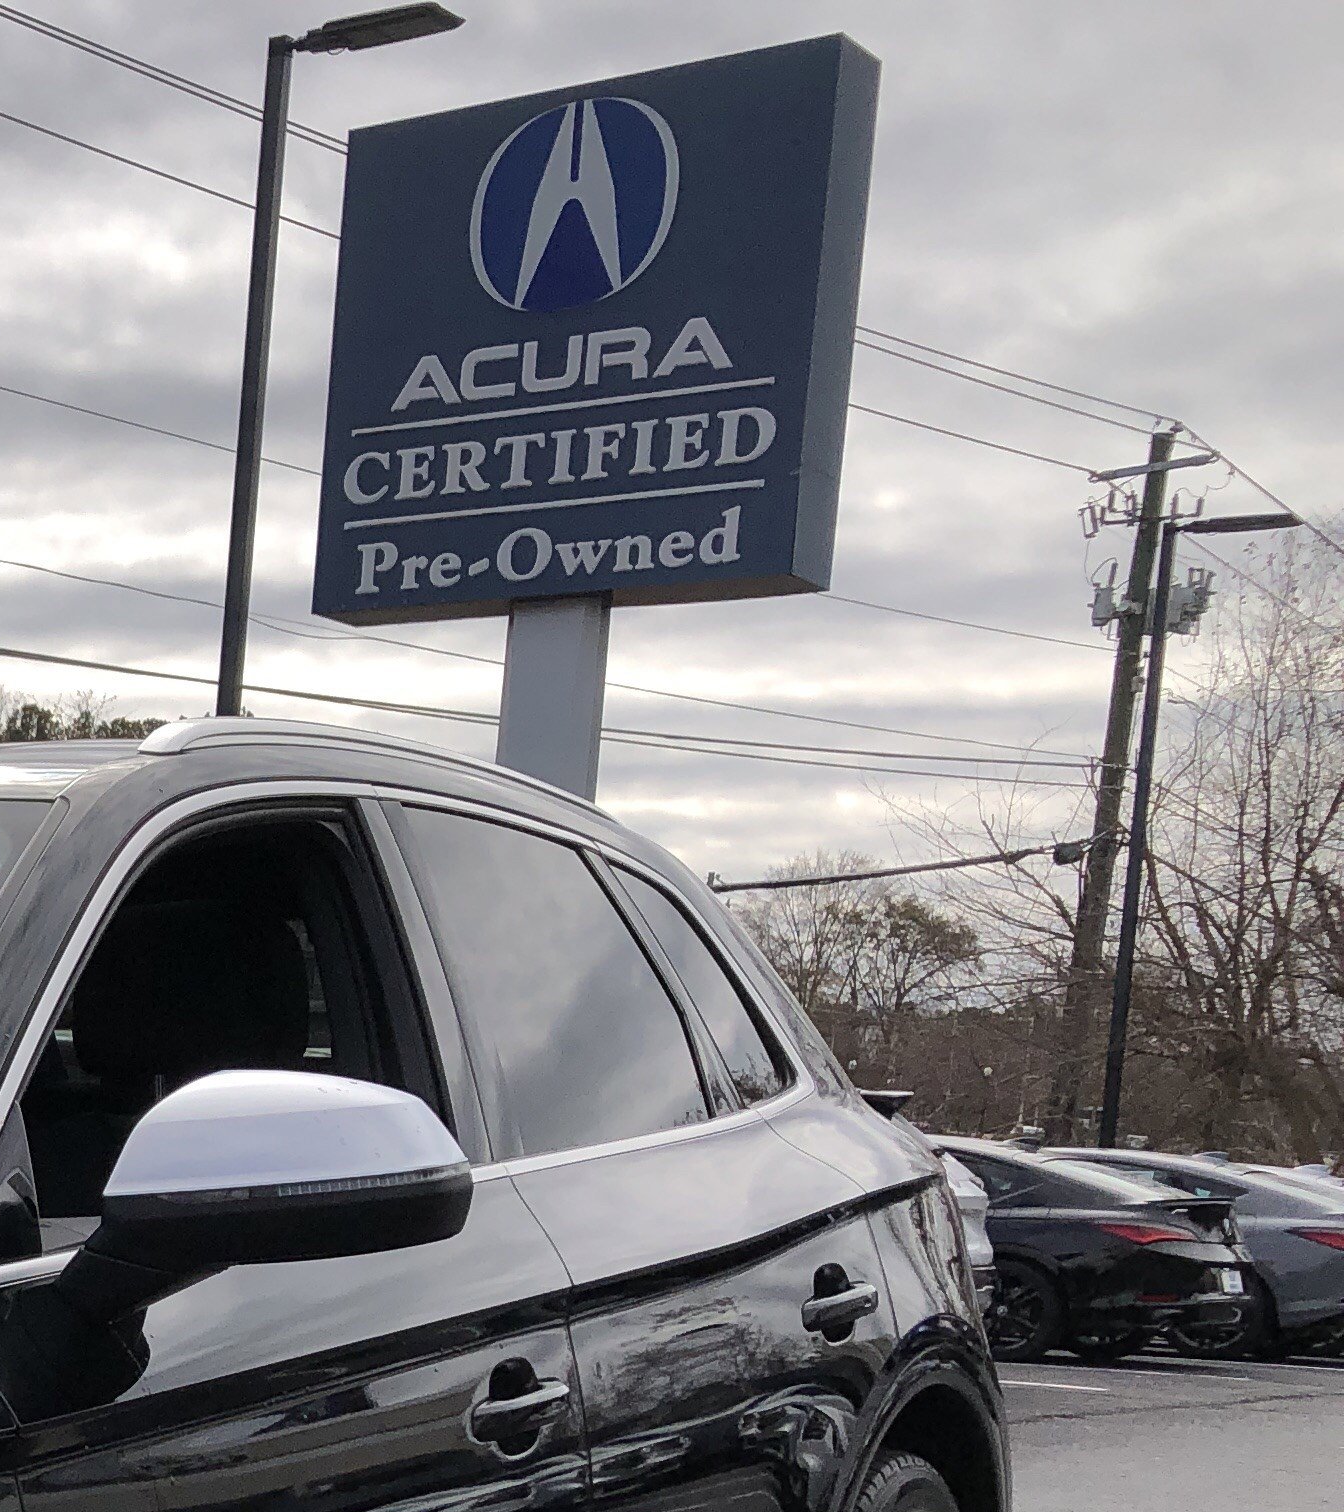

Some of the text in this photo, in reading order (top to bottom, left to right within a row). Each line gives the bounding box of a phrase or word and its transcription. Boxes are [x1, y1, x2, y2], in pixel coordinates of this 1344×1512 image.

[390, 317, 734, 412] ACURA
[343, 406, 777, 505] CERTIFIED
[354, 505, 742, 595] Pre-Owned
